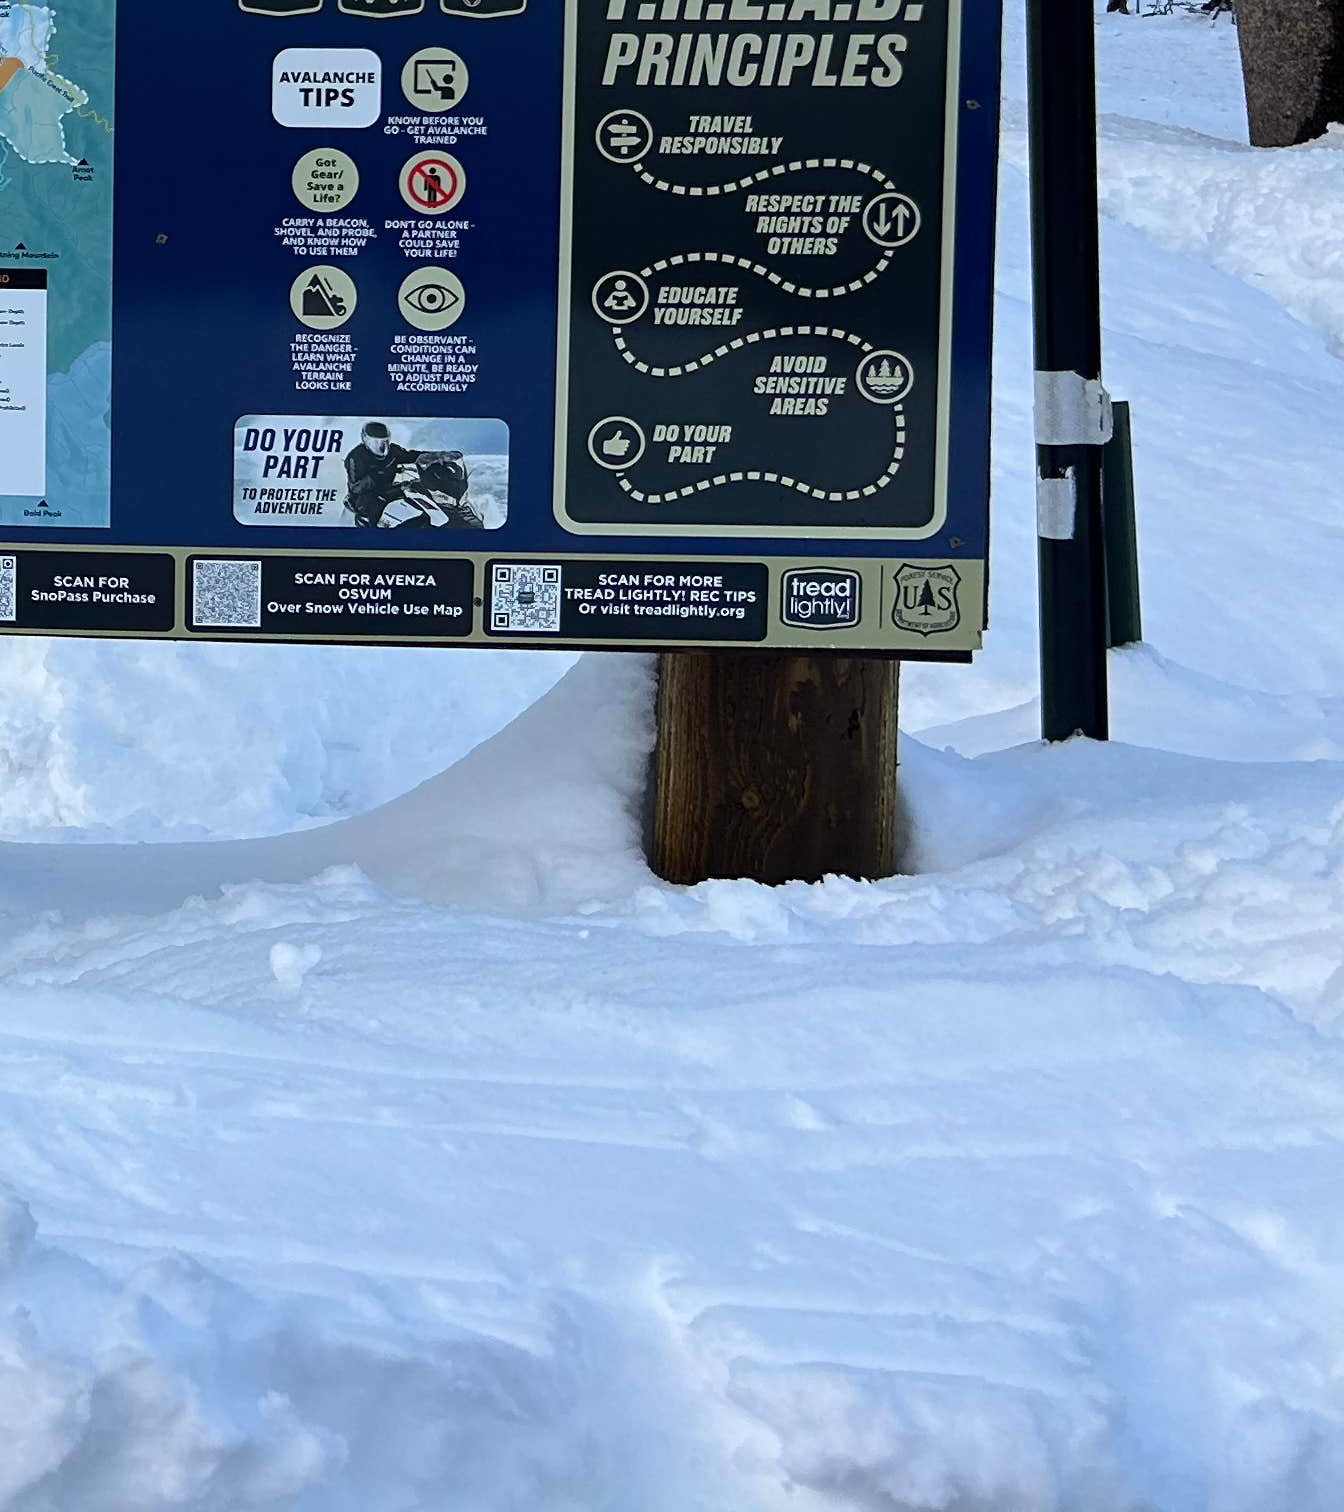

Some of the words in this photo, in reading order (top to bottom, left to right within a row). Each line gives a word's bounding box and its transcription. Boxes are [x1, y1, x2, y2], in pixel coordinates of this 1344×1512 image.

[601, 33, 907, 88] PRINCIPLES
[279, 71, 376, 84] AVALANCHE
[299, 88, 355, 108] TIPS
[689, 115, 753, 133] TRAVEL
[659, 137, 784, 155] RESPONSIBLY
[316, 158, 337, 167] Got
[311, 170, 344, 179] Gear/
[307, 182, 334, 191] Save
[313, 194, 341, 203] Life?
[745, 195, 824, 213] RESPECT
[828, 195, 863, 213] THE
[756, 216, 823, 234] RIGHTS
[827, 216, 850, 234] OF
[767, 237, 838, 256] OTHERS
[657, 286, 739, 304] EDUCATE
[653, 308, 744, 326] YOURSELF
[770, 356, 828, 373] AVOID
[754, 377, 847, 395] SENSITIVE
[769, 398, 829, 416] AREAS
[243, 429, 274, 452] DO
[283, 429, 344, 453] YOUR
[653, 425, 680, 442] DO
[684, 425, 732, 443] YOUR
[668, 446, 716, 464] PART
[263, 456, 324, 479] PART
[242, 488, 257, 500] TO
[259, 488, 313, 501] PROTECT
[316, 489, 337, 501] THE
[254, 502, 324, 515] ADVENTURE
[53, 575, 94, 589] SCAN
[98, 576, 129, 589] FOR
[294, 573, 335, 587] SCAN
[339, 573, 371, 587] FOR
[374, 573, 436, 587] AVENZA
[598, 573, 640, 587] SCAN
[644, 574, 676, 588] FOR
[679, 575, 723, 589] MORE
[791, 577, 851, 599] tread
[31, 589, 89, 604] SnoPass
[92, 592, 156, 606] Purchase
[338, 588, 392, 601] OSVUM
[565, 589, 616, 602] TREAD
[619, 589, 687, 603] LIGHTLY!
[690, 590, 720, 604] REC
[724, 591, 757, 604] TIPS
[267, 602, 300, 617] Over
[305, 603, 342, 617] Snow
[346, 602, 400, 617] Vehicle
[403, 604, 429, 617] Use
[433, 604, 463, 620] Map
[578, 602, 597, 616] Or
[601, 603, 630, 617] visit
[634, 604, 745, 621] treadlightly.org
[790, 597, 851, 619] lightly!
